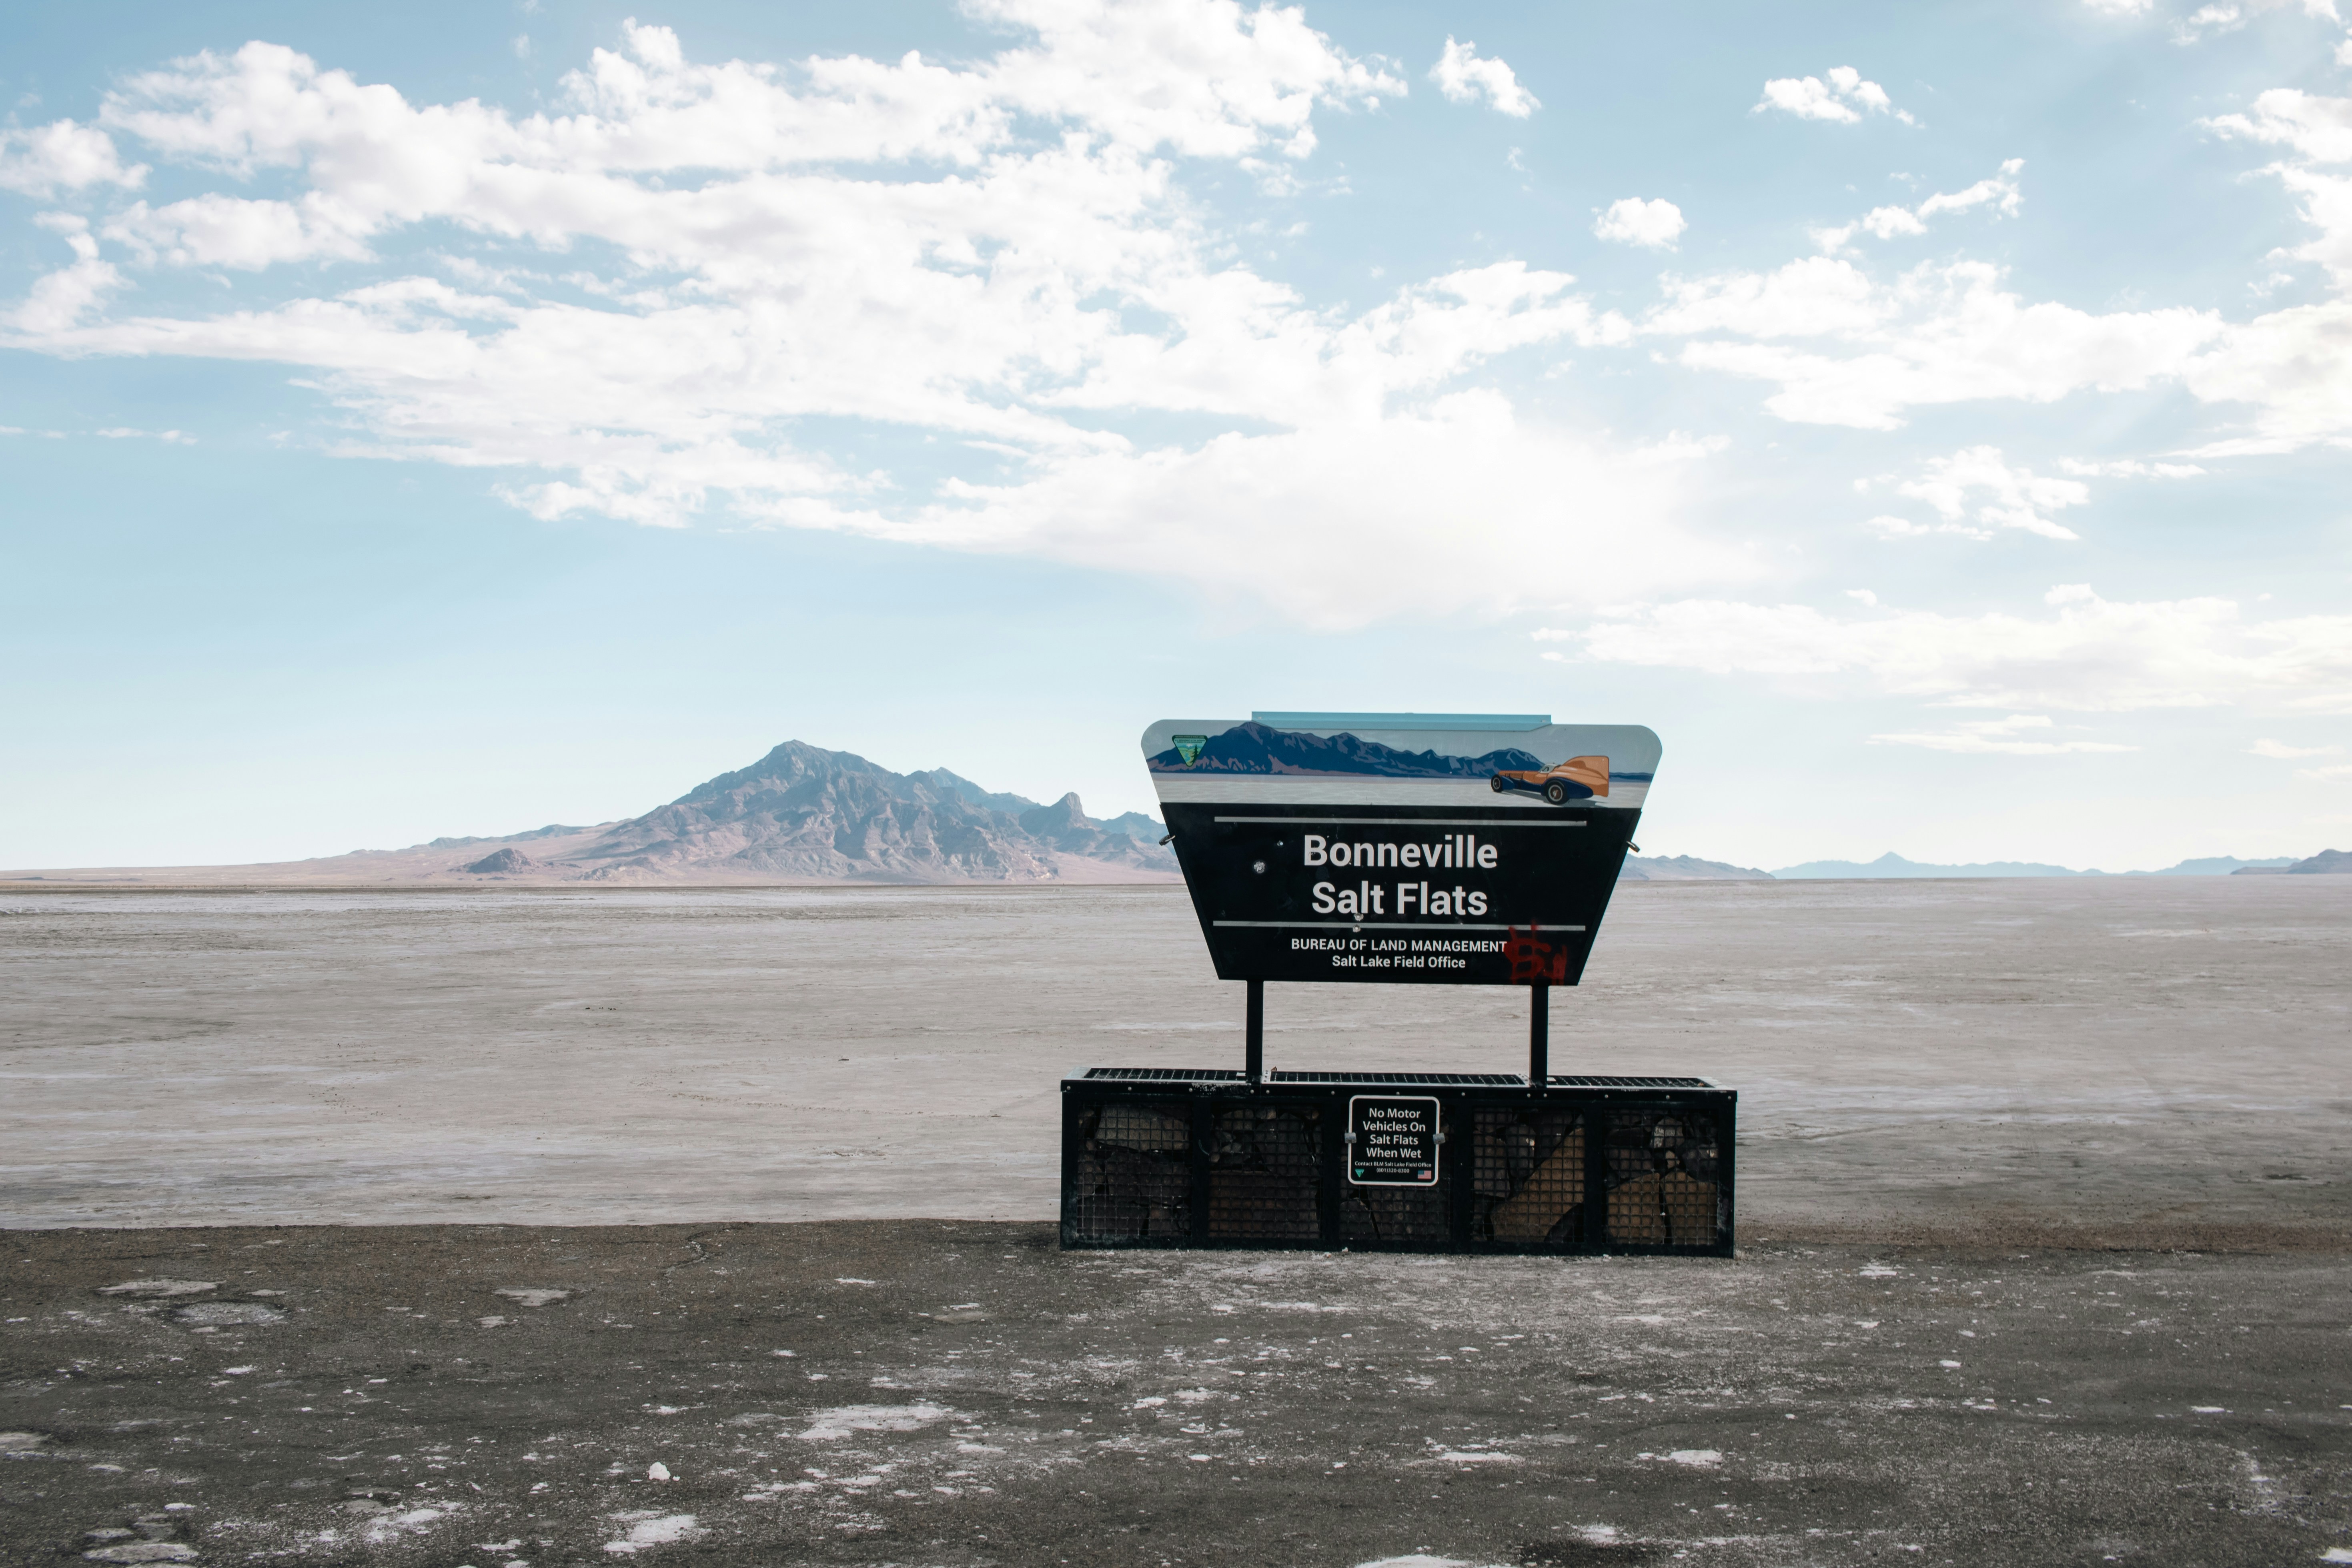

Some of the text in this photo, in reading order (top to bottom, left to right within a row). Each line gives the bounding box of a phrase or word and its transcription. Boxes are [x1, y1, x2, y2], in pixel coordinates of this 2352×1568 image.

[1304, 835, 1497, 868] Bonneville
[1312, 881, 1487, 915] Salt Flats
[1292, 939, 1507, 952] BUREAU OF LAND MANAGEMENT
[1332, 955, 1465, 968] Salt Lake Field Office
[1369, 1108, 1421, 1118] No Motor
[1363, 1121, 1426, 1131] Vehicles On
[1370, 1134, 1418, 1145] Salt Flats
[1366, 1147, 1421, 1158] When Wet
